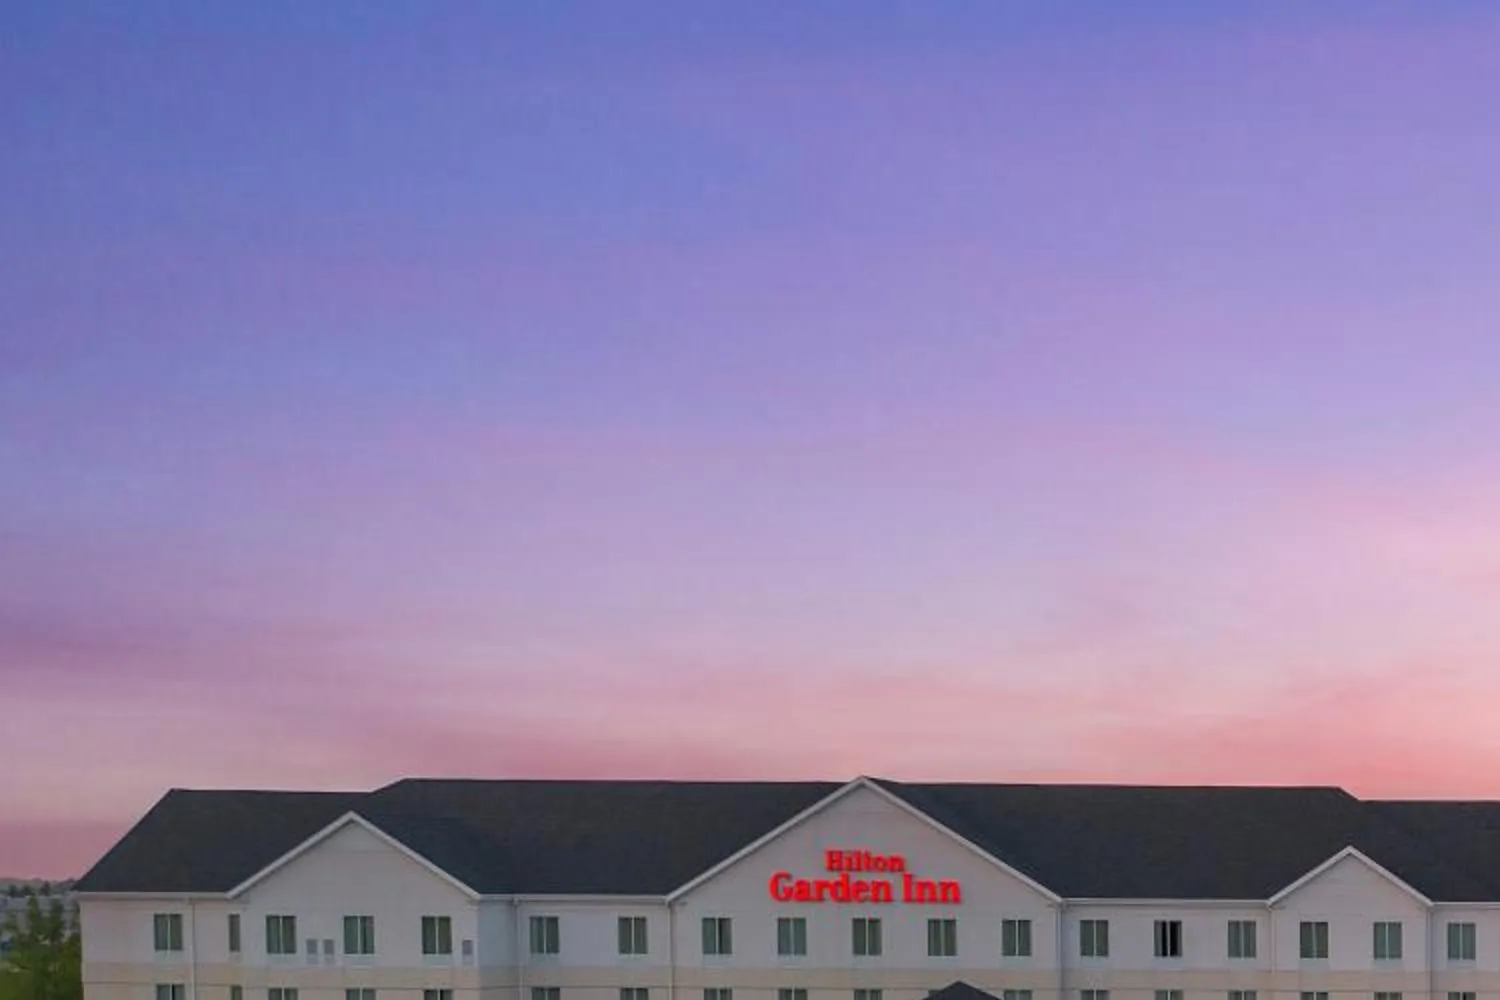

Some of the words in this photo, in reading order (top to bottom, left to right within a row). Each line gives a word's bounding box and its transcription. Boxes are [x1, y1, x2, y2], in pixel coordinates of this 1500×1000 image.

[825, 849, 905, 871] Hilton
[769, 871, 893, 903] Garden
[902, 873, 961, 903] Inn
